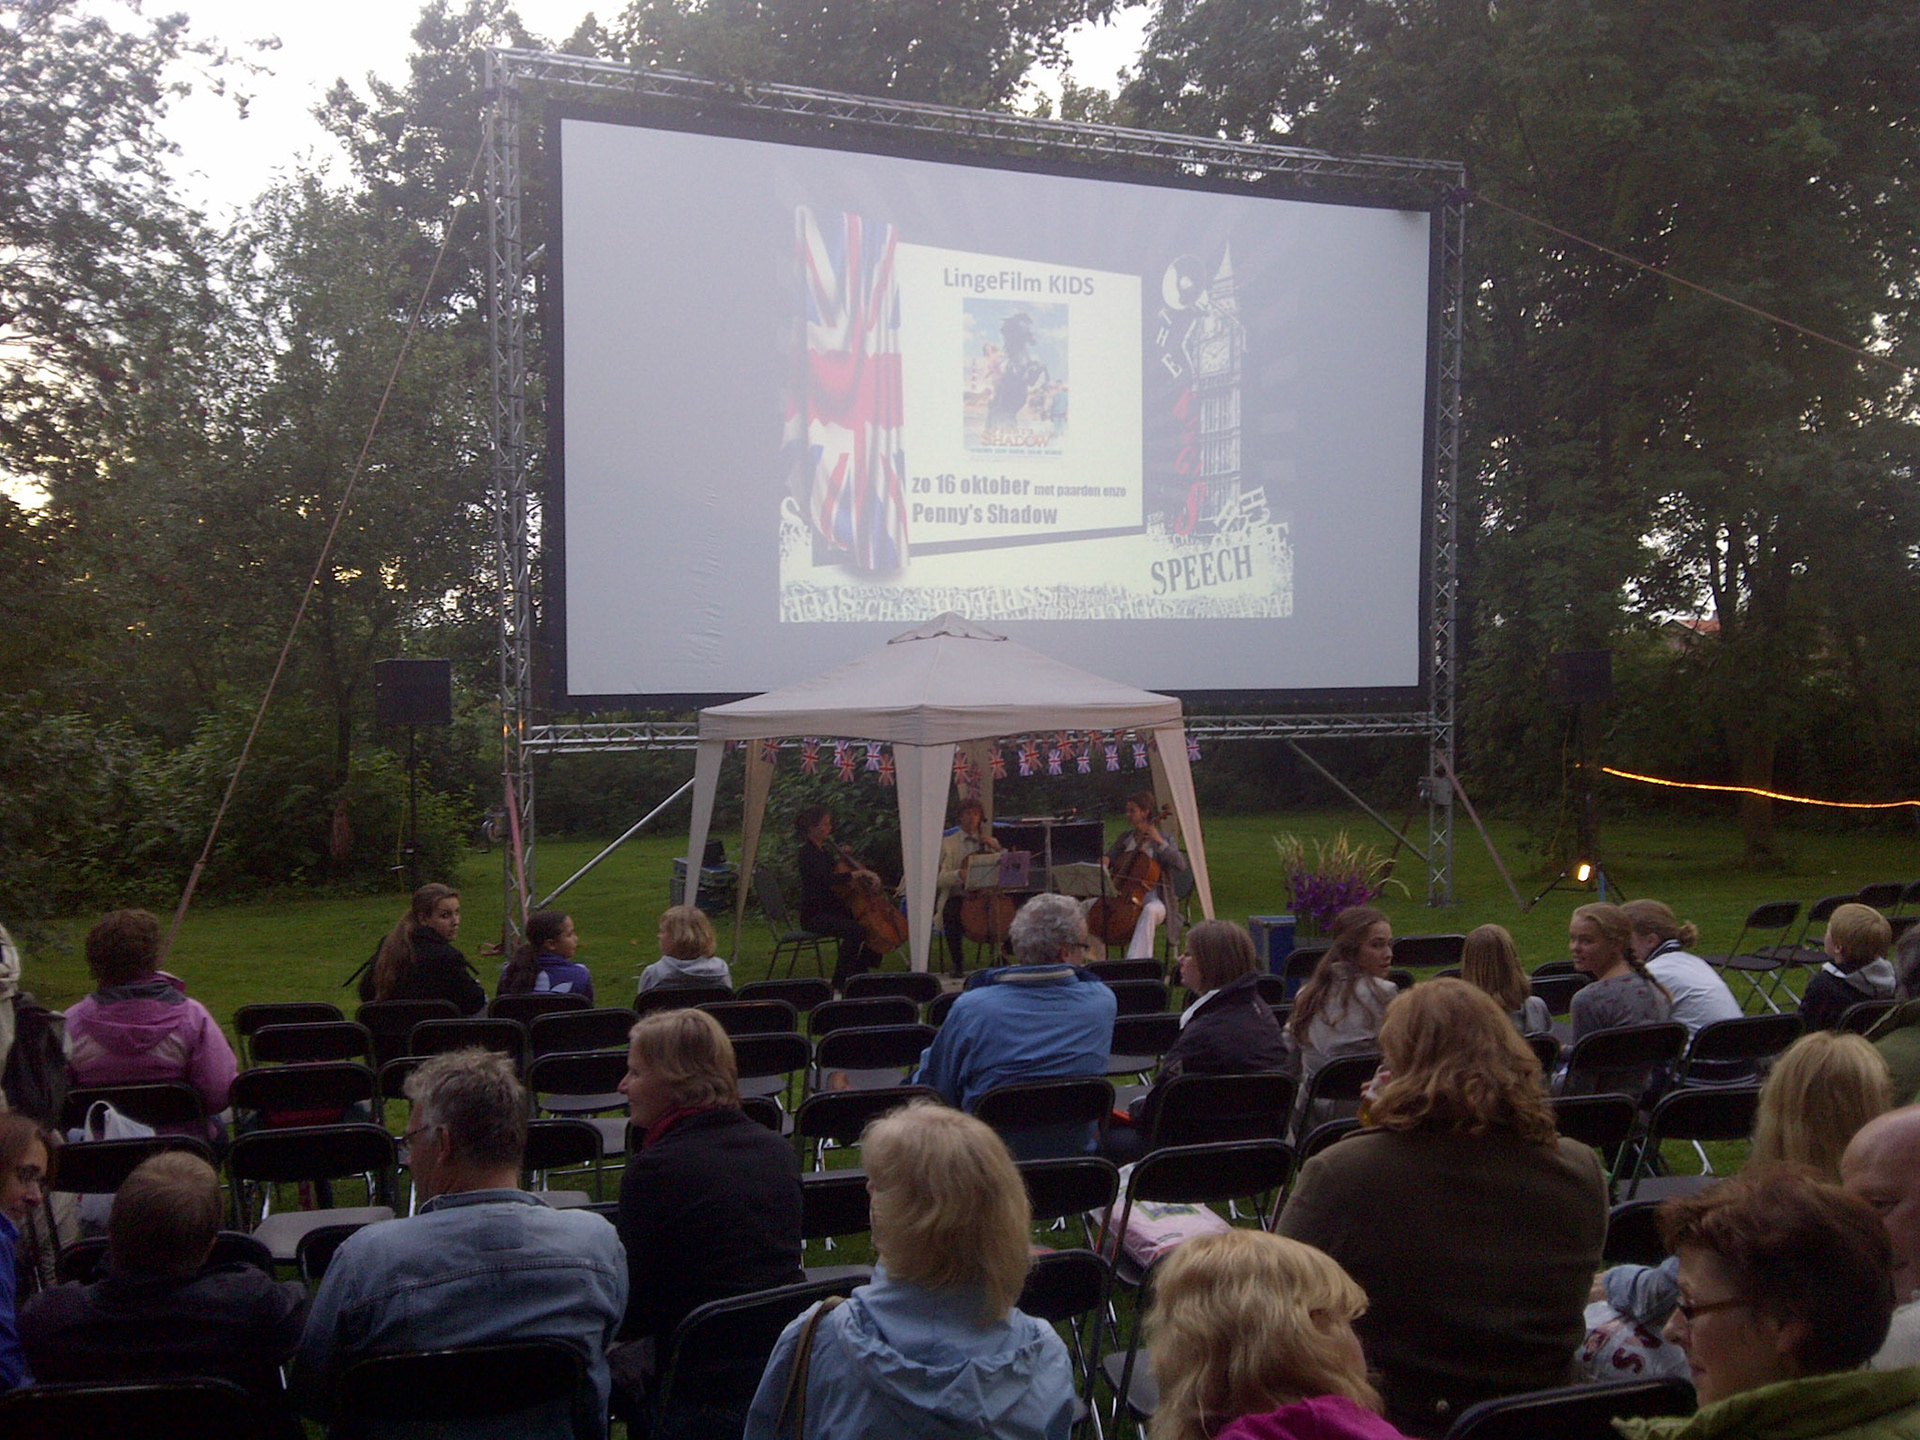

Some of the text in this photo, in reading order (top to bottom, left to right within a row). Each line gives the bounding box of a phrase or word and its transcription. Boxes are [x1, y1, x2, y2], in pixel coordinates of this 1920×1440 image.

[943, 267, 1095, 296] LingeFilm KIDS
[913, 476, 932, 494] zo
[937, 474, 956, 495] 16
[960, 474, 1030, 496] oktober
[1034, 485, 1055, 497] met
[1057, 484, 1101, 498] paarden
[913, 503, 1058, 526] Penny's Shadow
[1150, 544, 1253, 597] SPEECH
